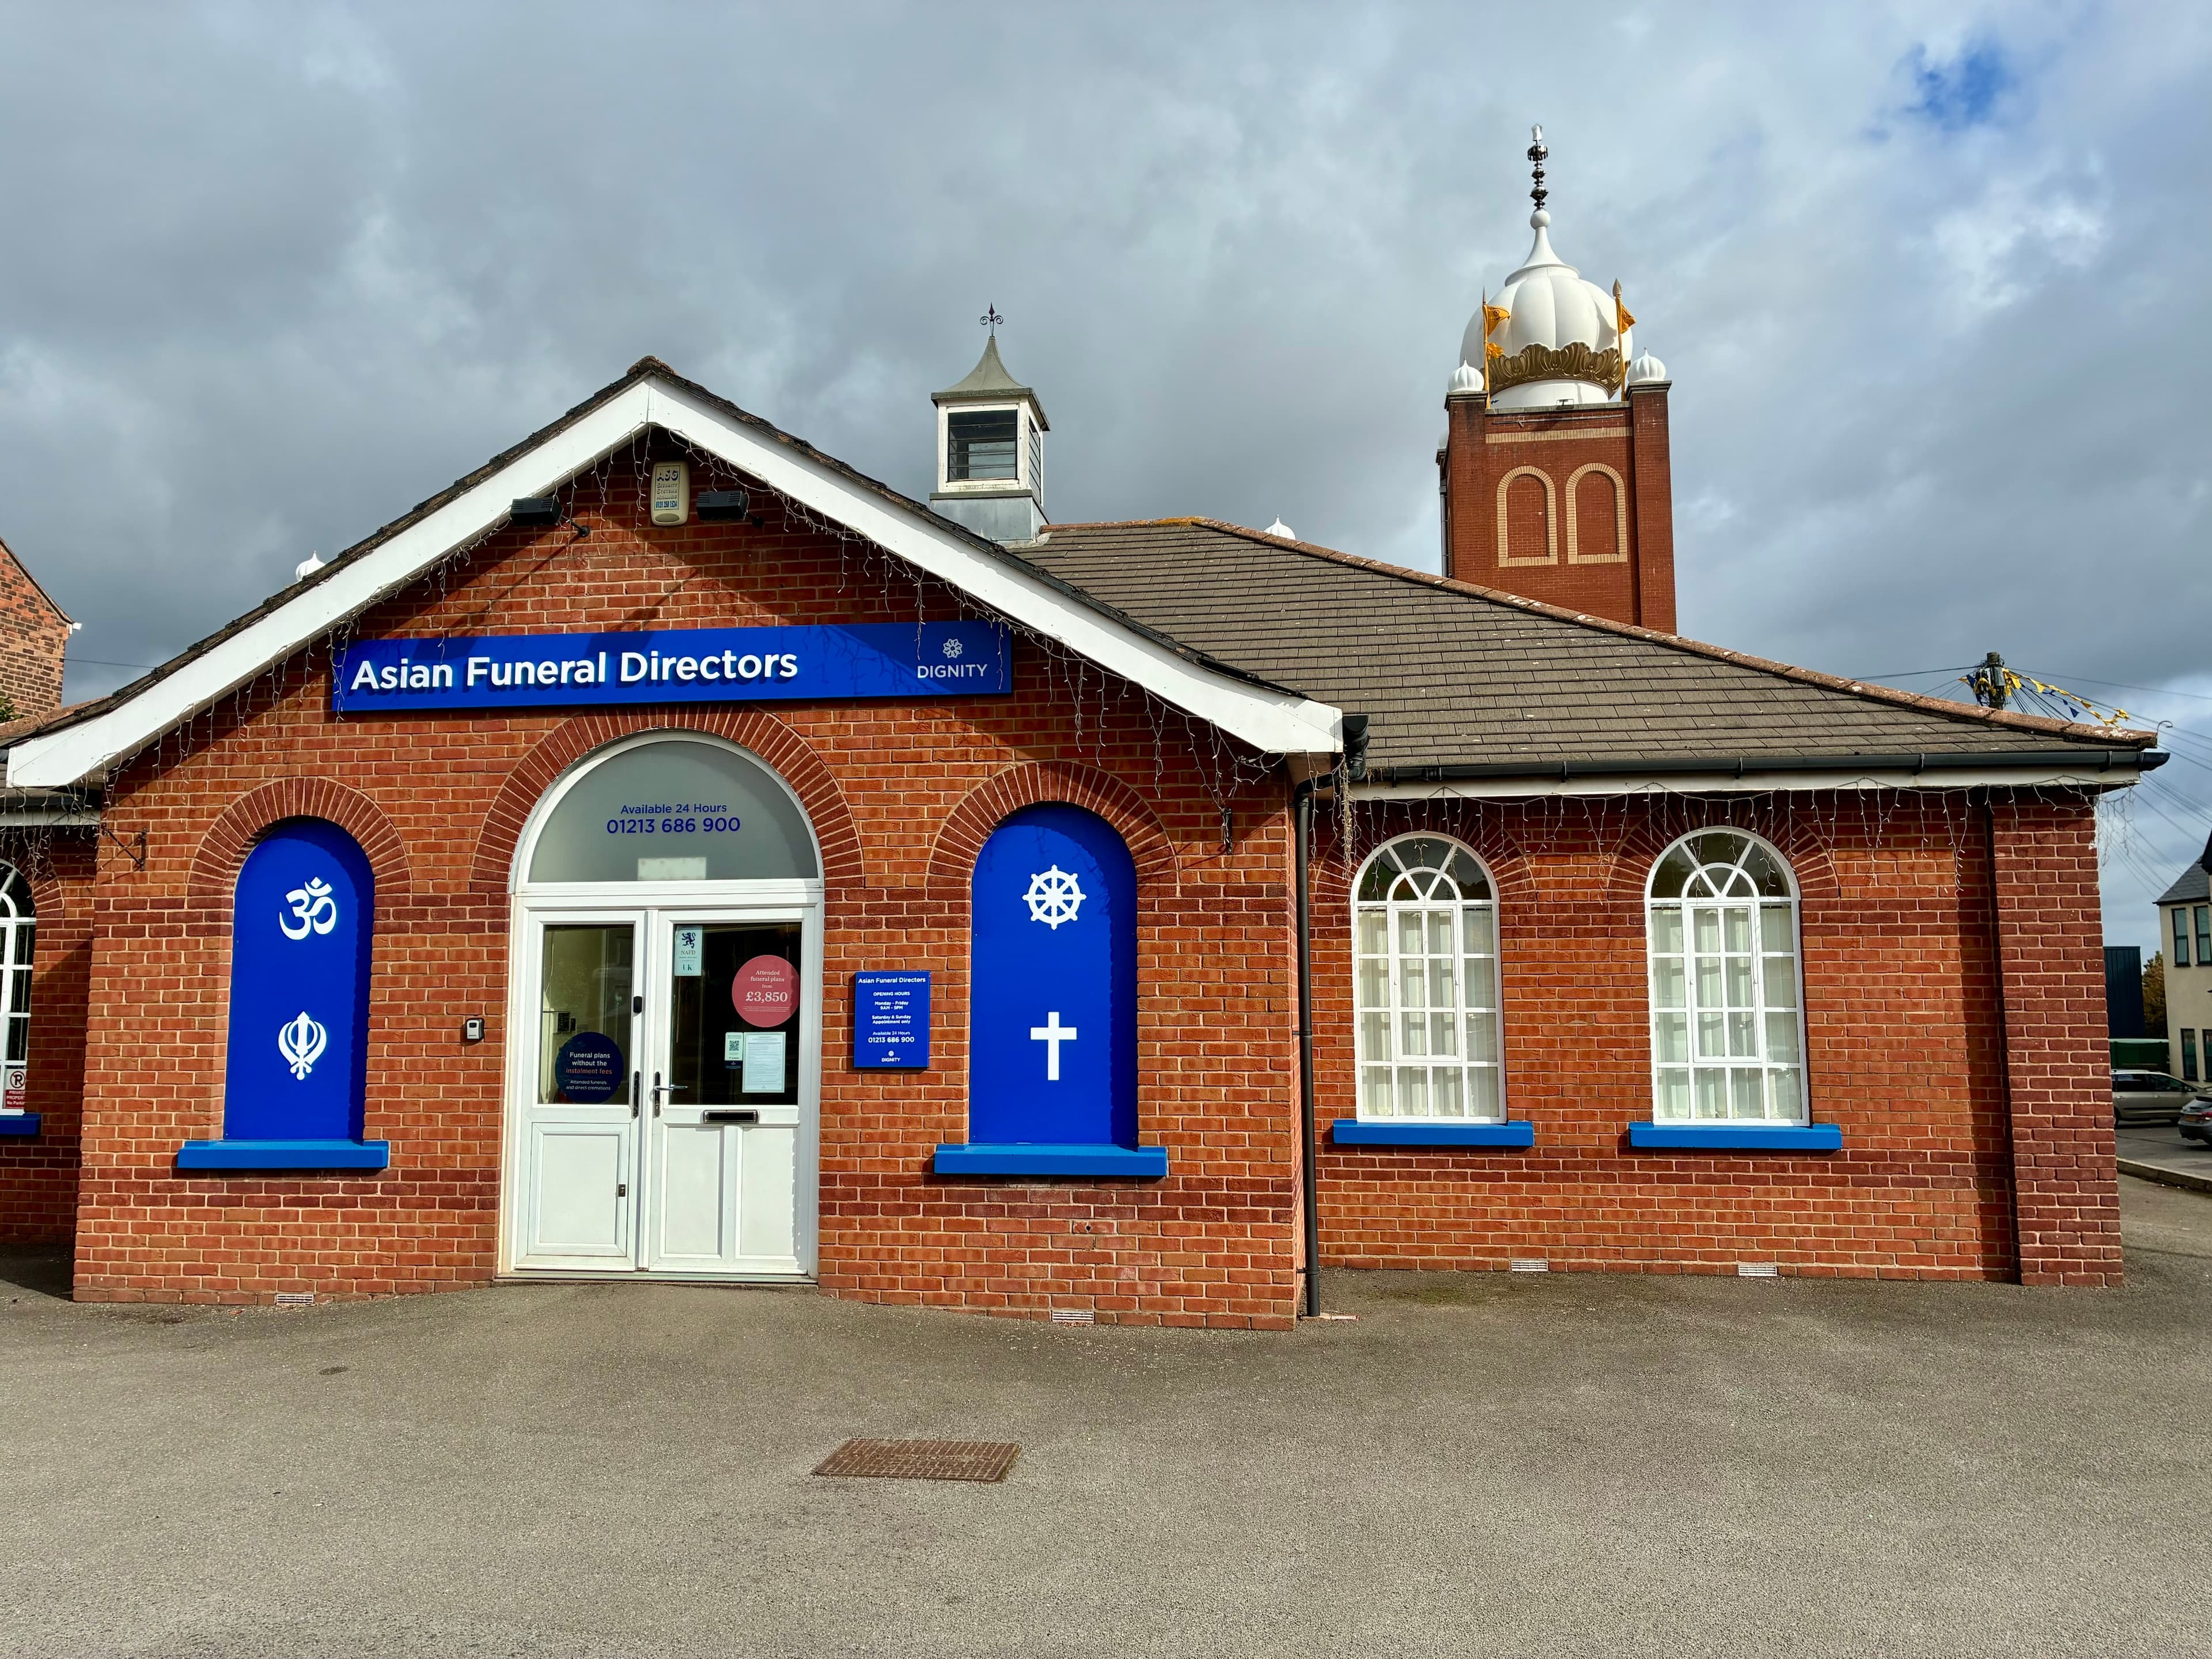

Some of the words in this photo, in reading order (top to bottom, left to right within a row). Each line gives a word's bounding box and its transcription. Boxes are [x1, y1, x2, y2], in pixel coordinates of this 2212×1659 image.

[657, 469, 679, 481] ASG
[351, 658, 453, 690] Asian
[467, 652, 607, 687] Funeral
[620, 650, 798, 682] Directors
[917, 664, 988, 679] DIGNITY
[620, 804, 672, 814] Available
[676, 804, 690, 813] 24
[694, 804, 727, 813] Hours
[607, 819, 655, 834] 01213
[662, 818, 696, 833] 686
[703, 817, 741, 832] 900
[745, 991, 788, 1003] £3,850
